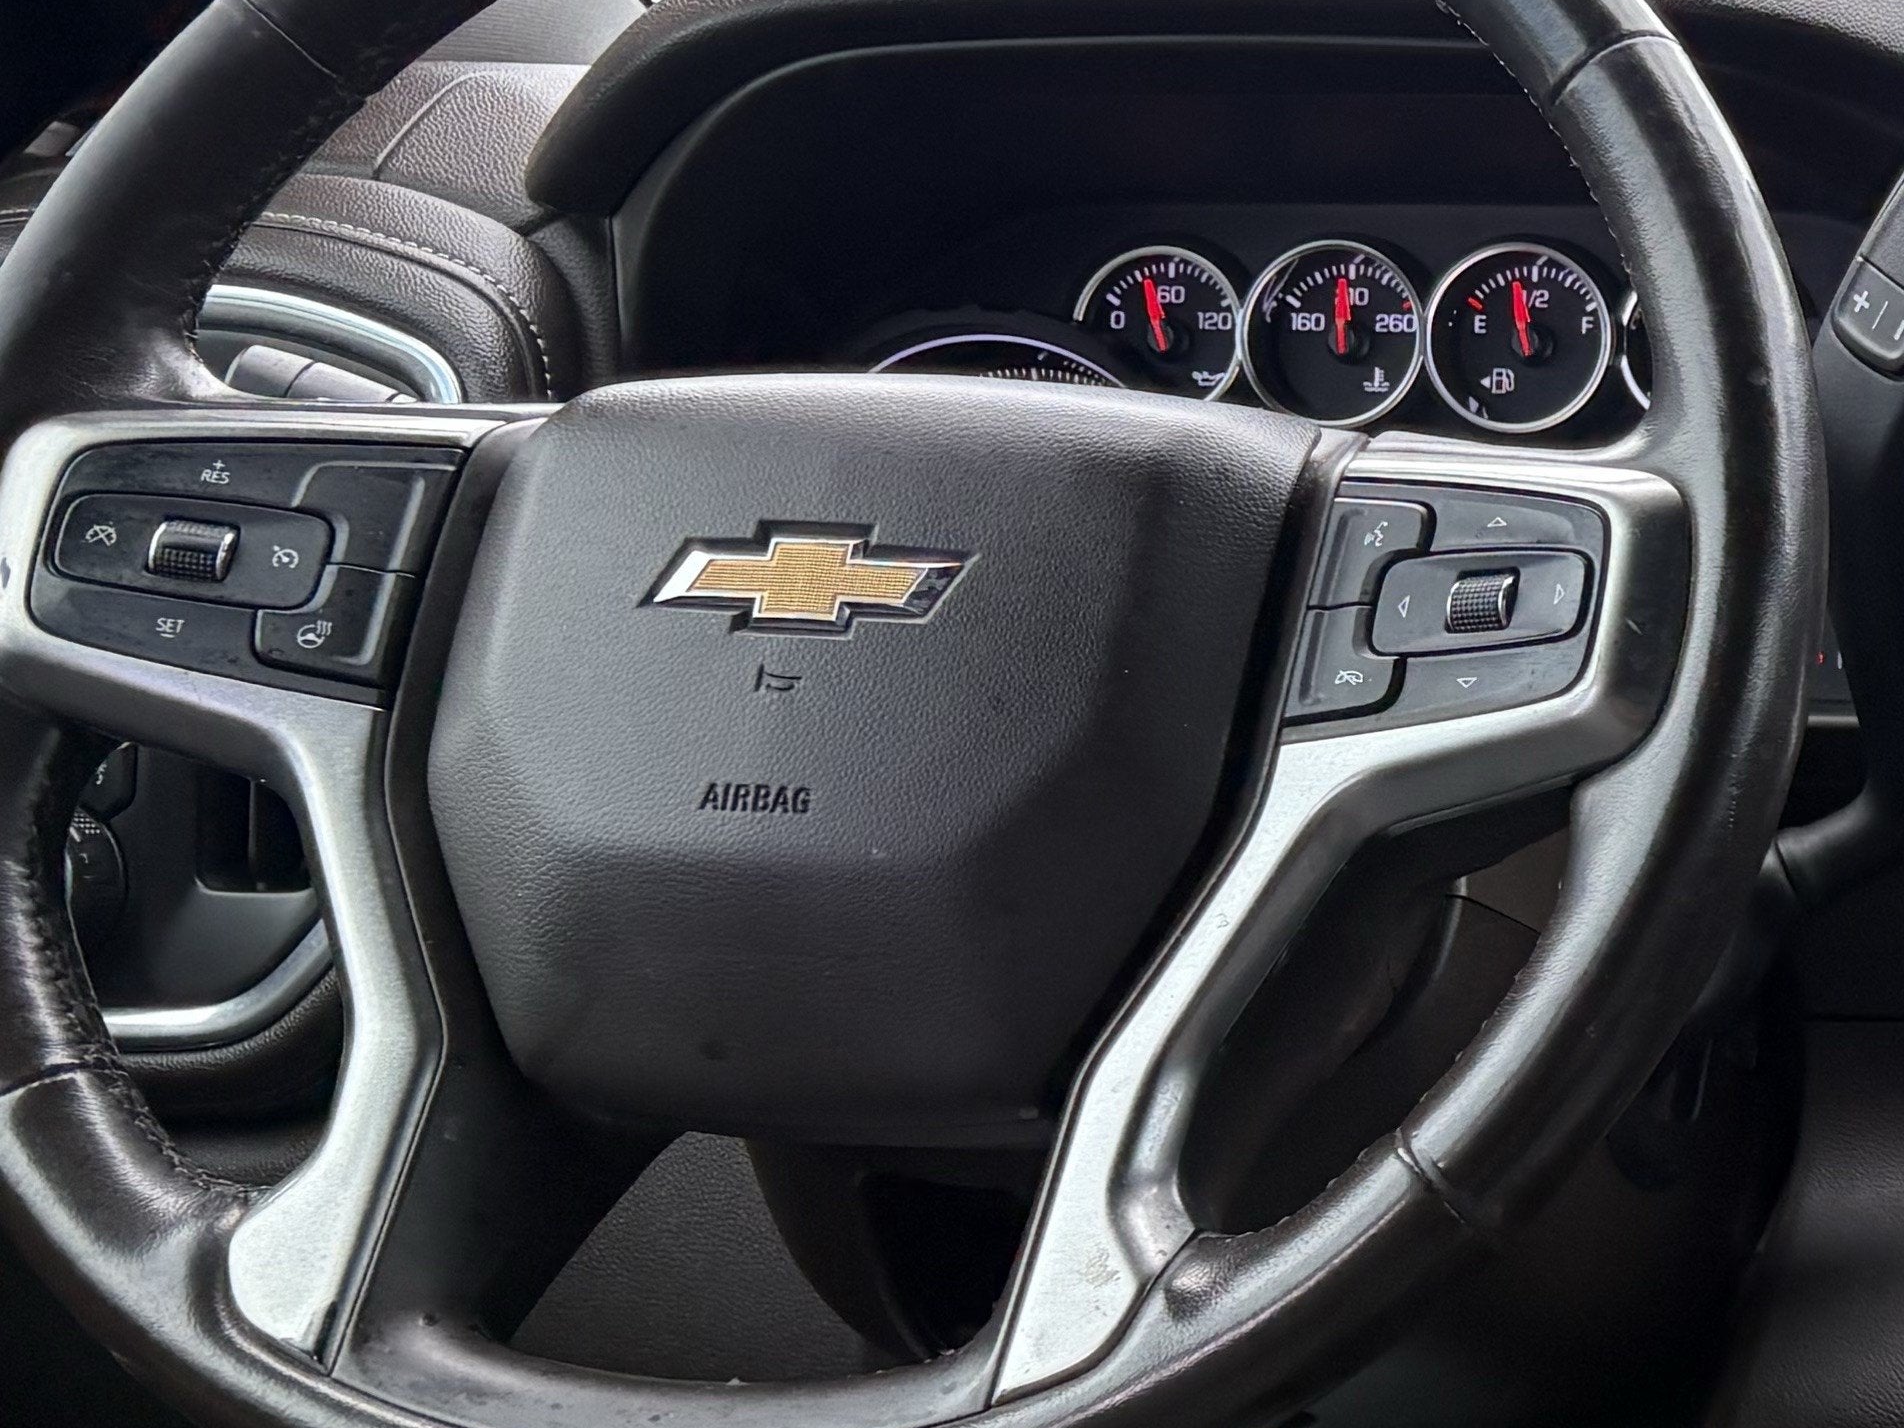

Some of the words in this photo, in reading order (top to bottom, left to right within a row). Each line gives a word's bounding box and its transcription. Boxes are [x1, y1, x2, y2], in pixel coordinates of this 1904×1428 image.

[1156, 285, 1186, 305] 60
[1336, 287, 1370, 306] 10
[1111, 312, 1125, 329] 0
[1197, 312, 1232, 331] 120
[1289, 312, 1326, 332] 160
[1375, 314, 1418, 333] 260
[1473, 315, 1487, 333] E
[1581, 317, 1594, 334] F
[201, 470, 230, 485] RES
[156, 618, 184, 633] SET
[698, 782, 812, 814] AIRBAG
